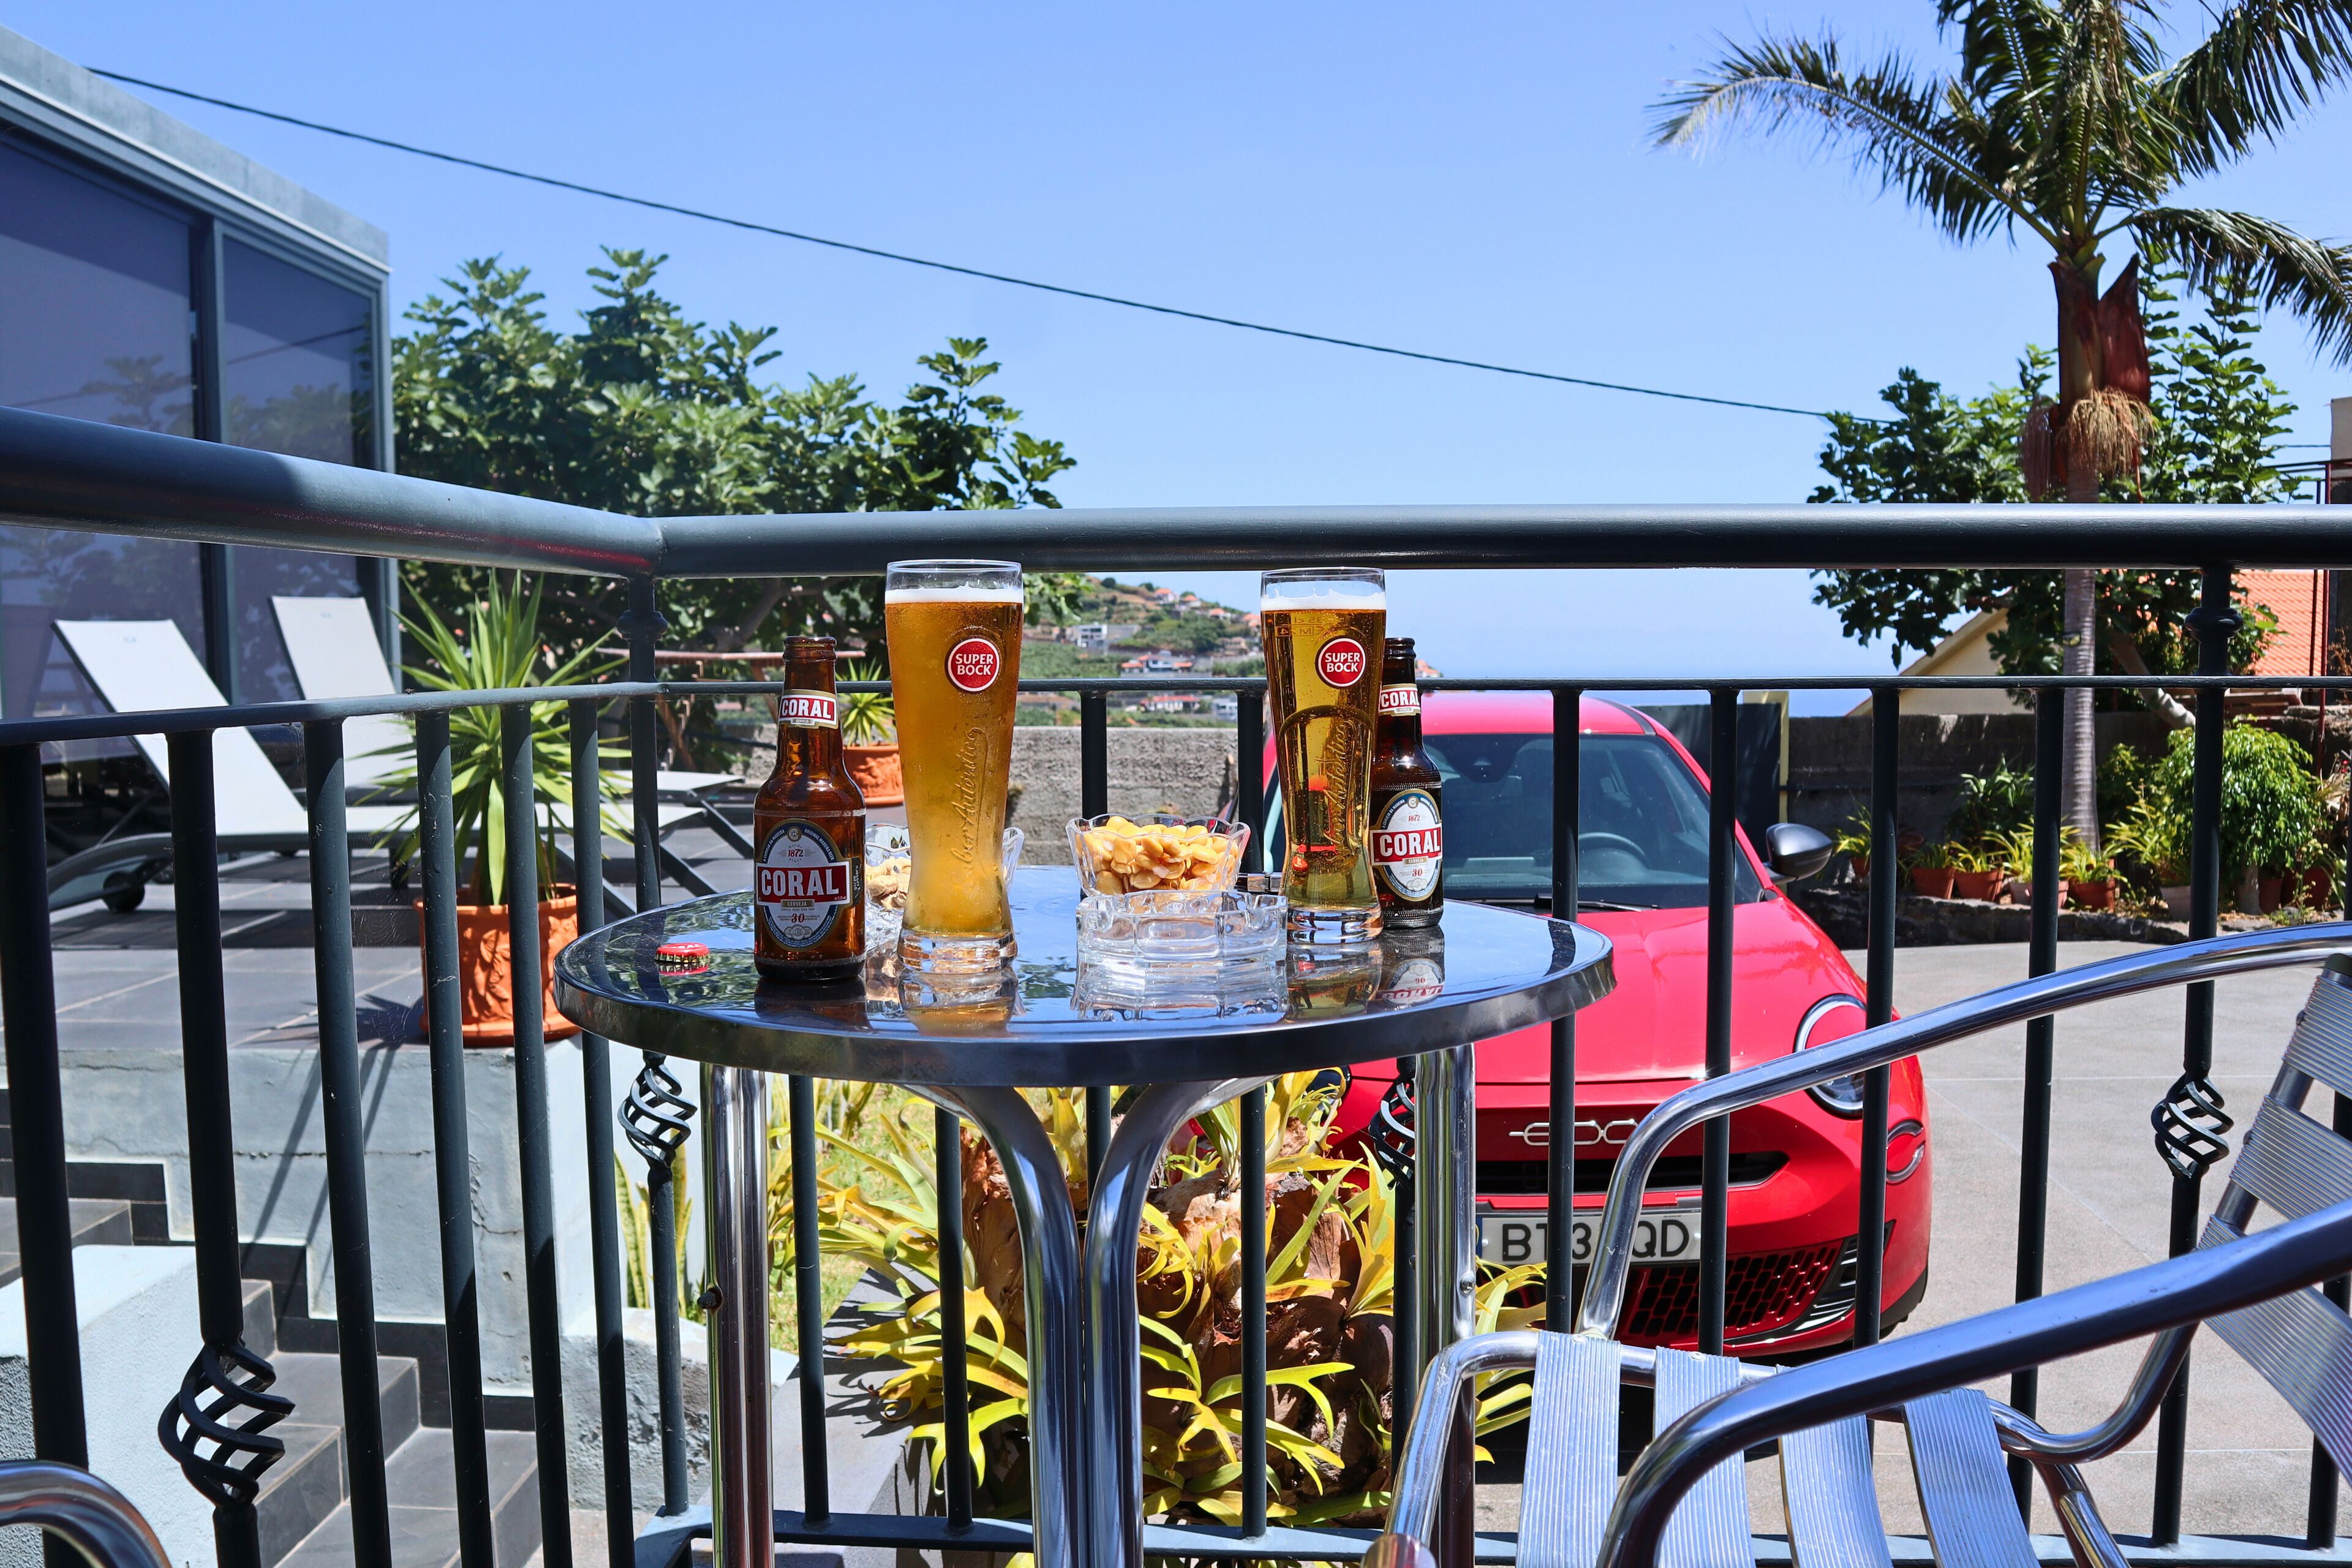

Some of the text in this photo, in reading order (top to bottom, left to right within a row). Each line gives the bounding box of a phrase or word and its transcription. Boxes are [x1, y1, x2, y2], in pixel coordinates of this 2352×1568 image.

[956, 654, 993, 665] SUPER
[1325, 652, 1360, 663] SUPER
[957, 665, 991, 676] BOCK
[1327, 662, 1359, 673] BOCK
[1381, 691, 1420, 707] CORAL
[782, 699, 831, 719] CORAL
[772, 829, 785, 840] MADEIRA
[804, 828, 820, 840] ORIGINAL
[818, 837, 831, 853] MADEIRA
[1379, 829, 1441, 857] CORAL
[788, 848, 804, 857] 1872
[1412, 868, 1422, 876] 30
[761, 869, 839, 896] CORAL
[791, 913, 805, 923] 30
